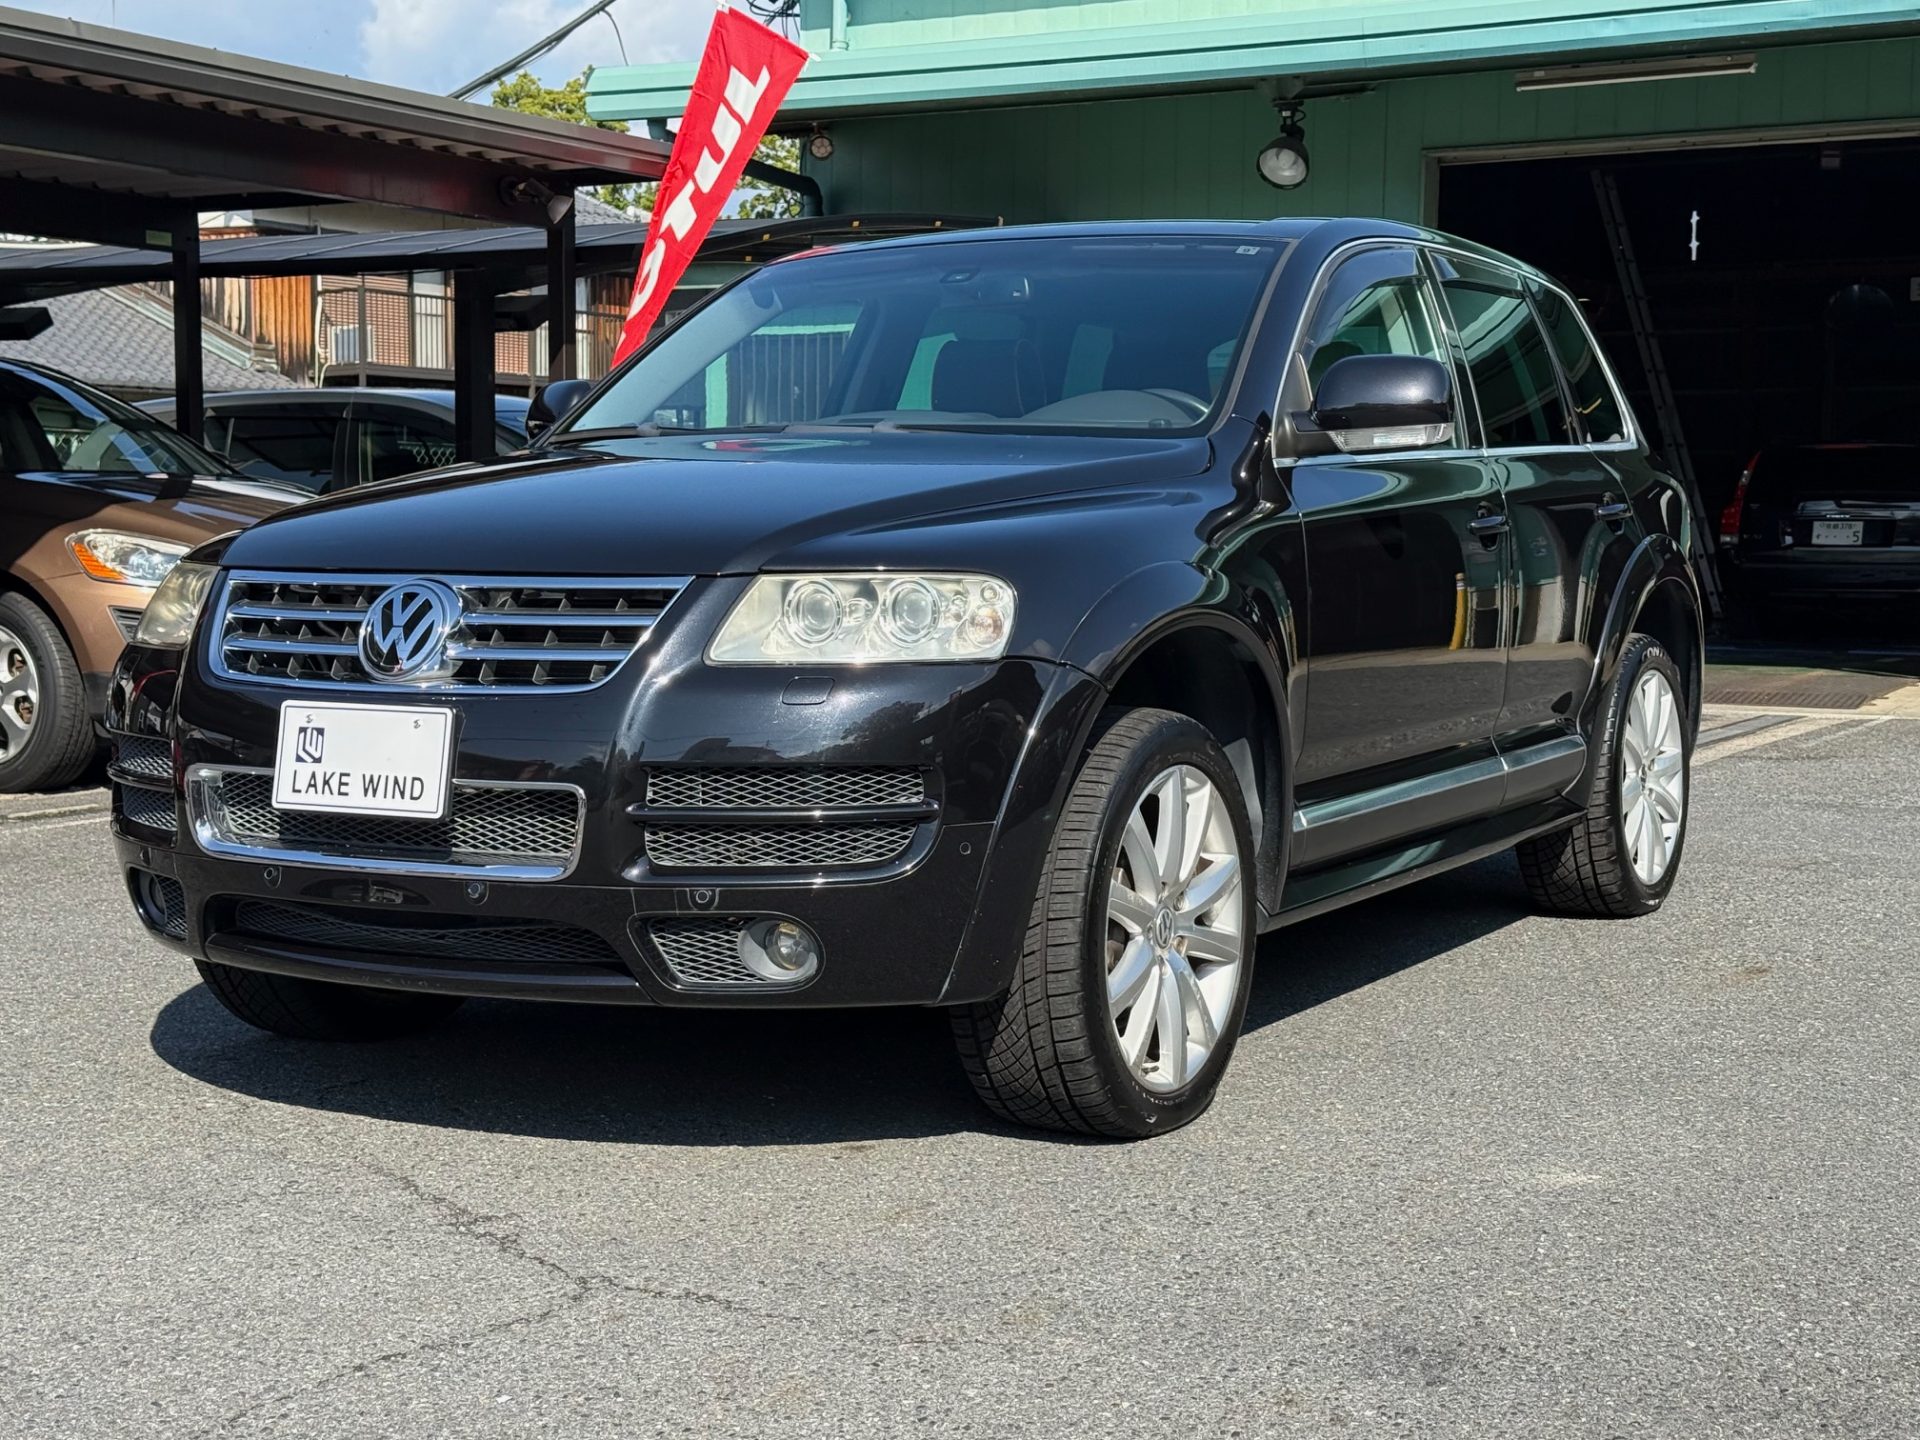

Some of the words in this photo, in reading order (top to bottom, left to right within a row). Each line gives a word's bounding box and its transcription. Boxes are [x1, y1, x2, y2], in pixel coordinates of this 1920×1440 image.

[615, 65, 770, 352] OTUL
[291, 769, 351, 796] LAKE
[362, 773, 425, 801] WIND
